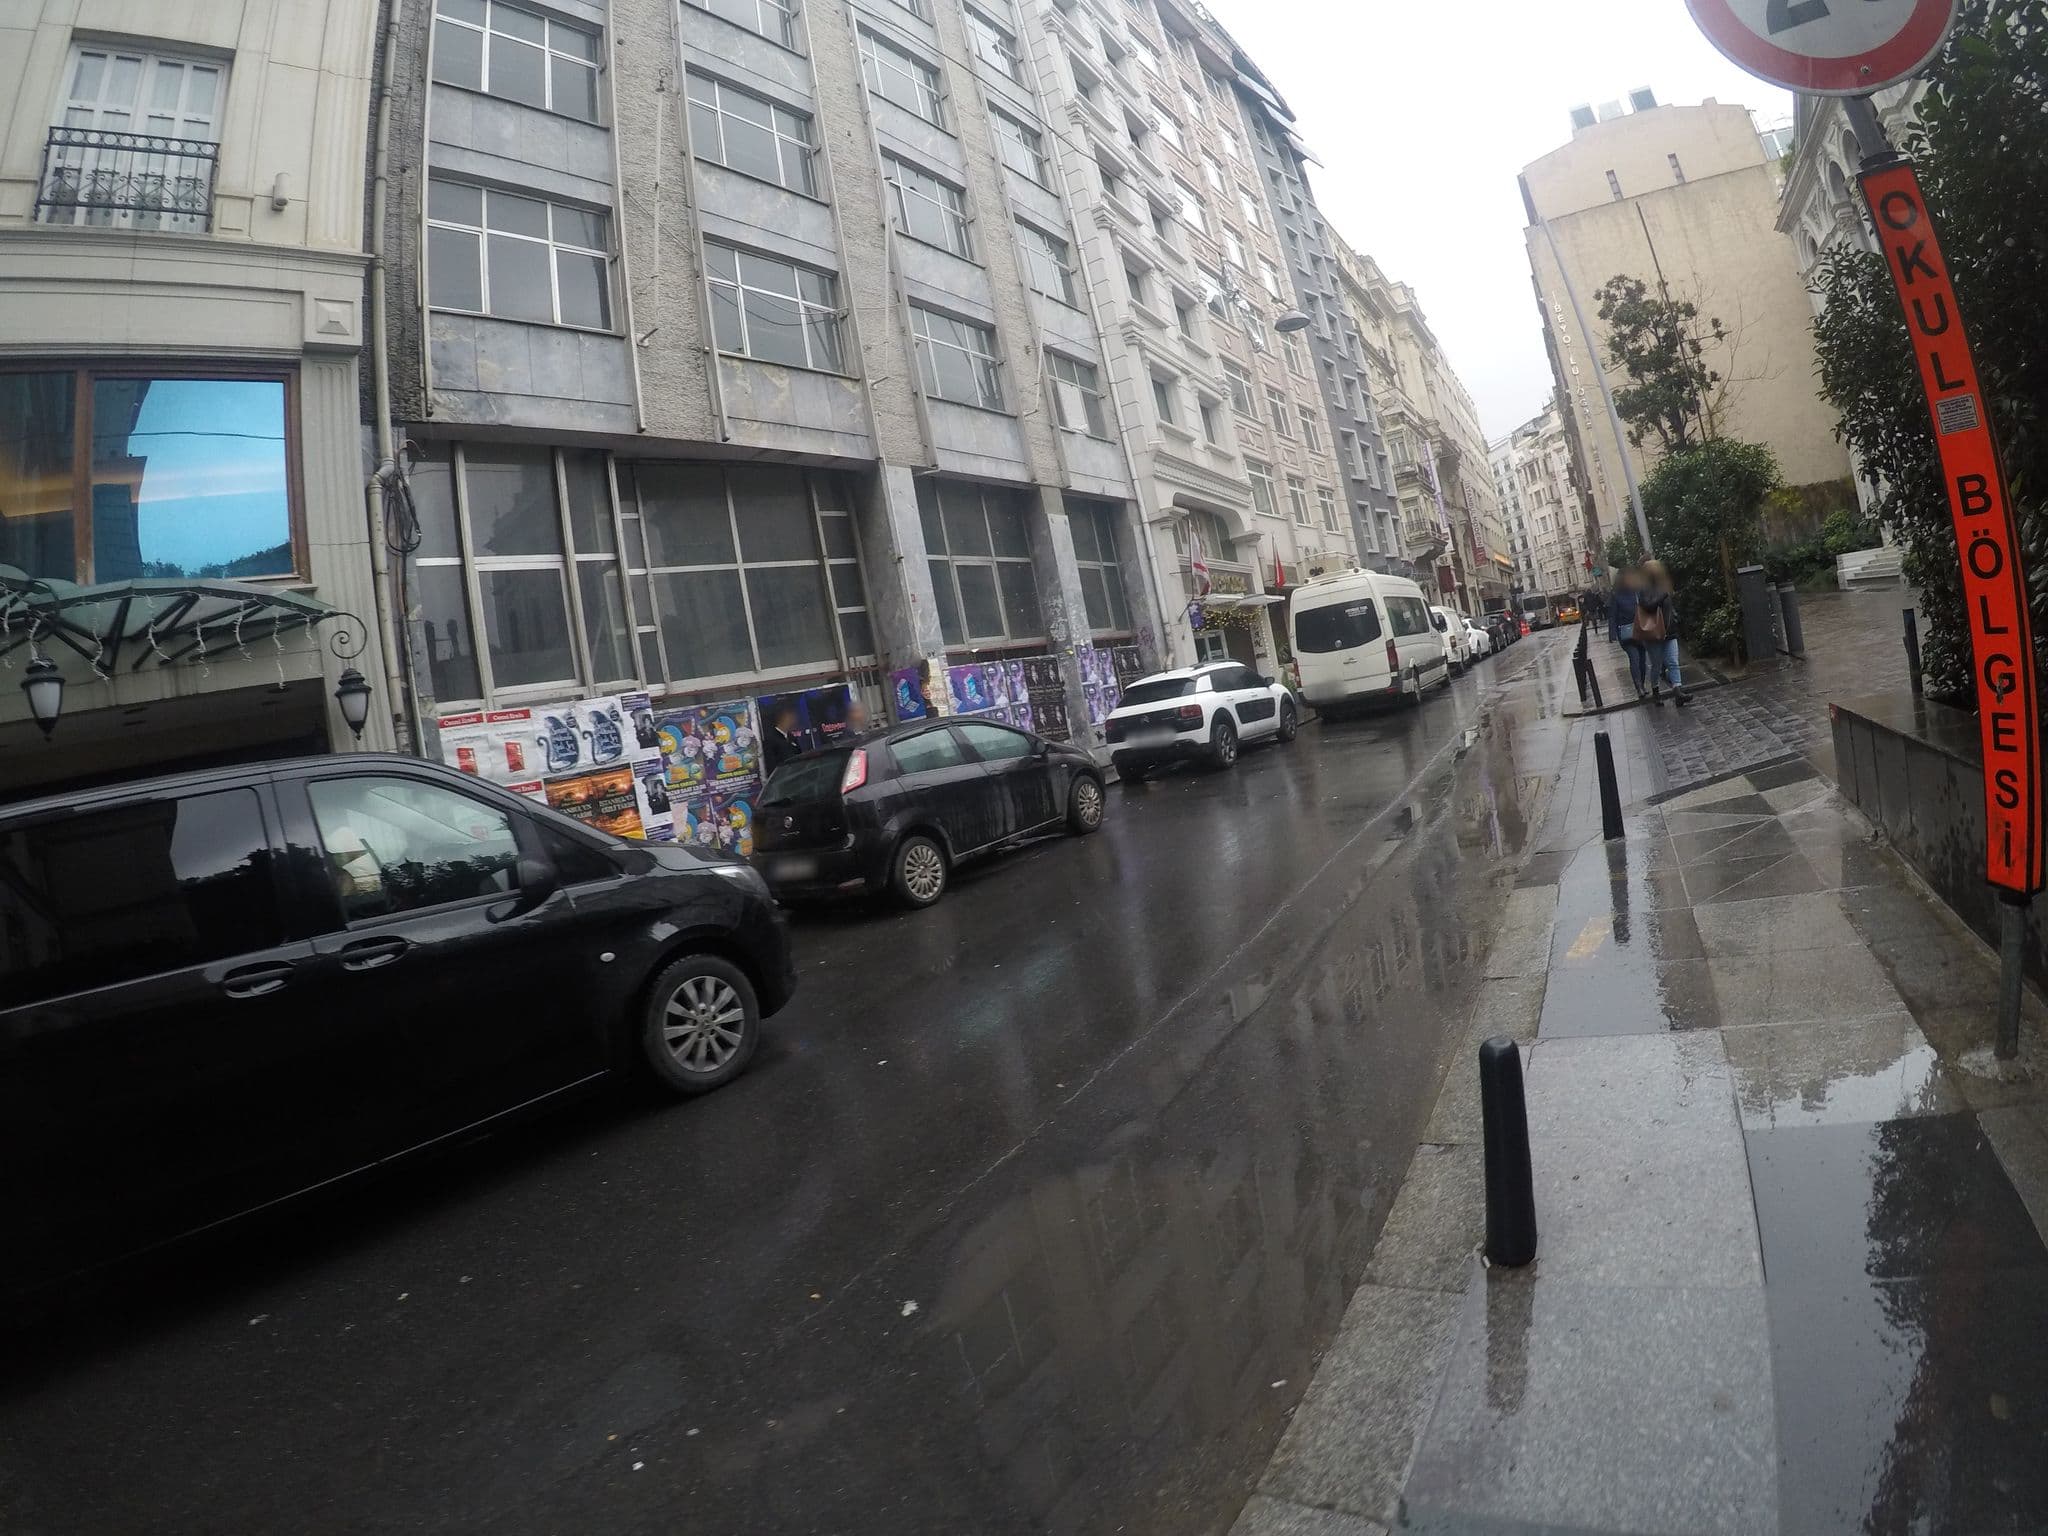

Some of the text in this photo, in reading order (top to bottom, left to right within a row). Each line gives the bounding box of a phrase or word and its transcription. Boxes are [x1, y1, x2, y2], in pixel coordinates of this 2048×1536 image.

[1554, 304, 1580, 375] BEYOLU
[1879, 190, 1966, 392] OKUL
[1956, 473, 2019, 868] BÖLGESİ
